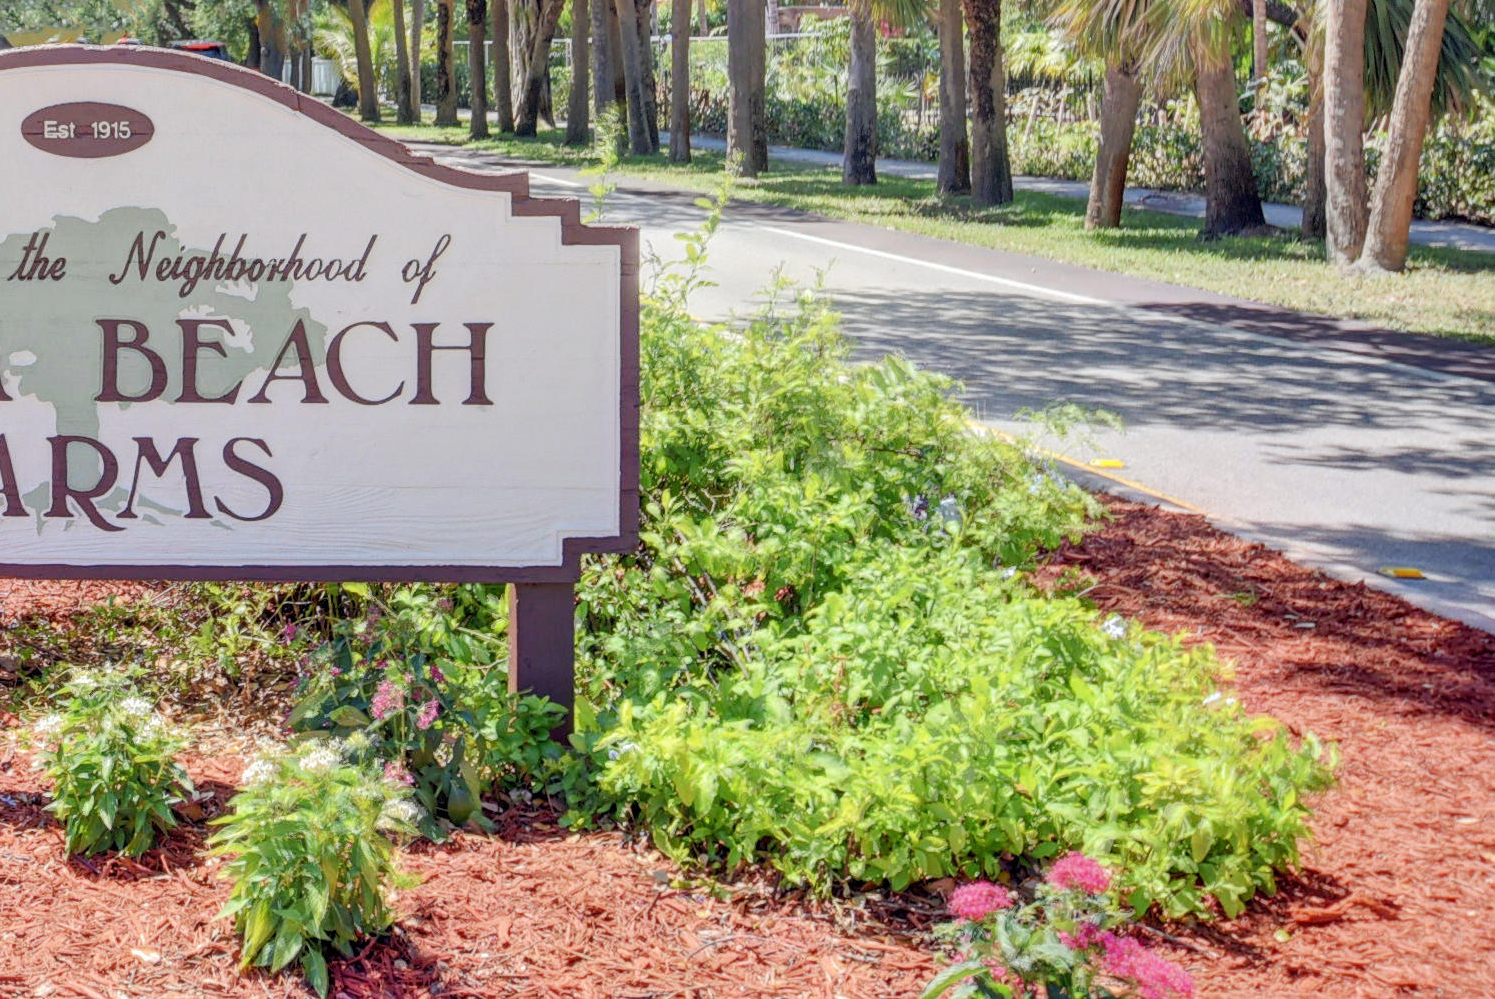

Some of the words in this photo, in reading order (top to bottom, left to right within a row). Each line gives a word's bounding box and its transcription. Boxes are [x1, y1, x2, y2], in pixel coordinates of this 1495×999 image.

[43, 120, 76, 139] Est
[91, 121, 131, 140] 1915
[7, 231, 67, 282] the
[108, 230, 378, 299] Neighborhood
[401, 233, 452, 305] of
[92, 317, 496, 406] BEACH
